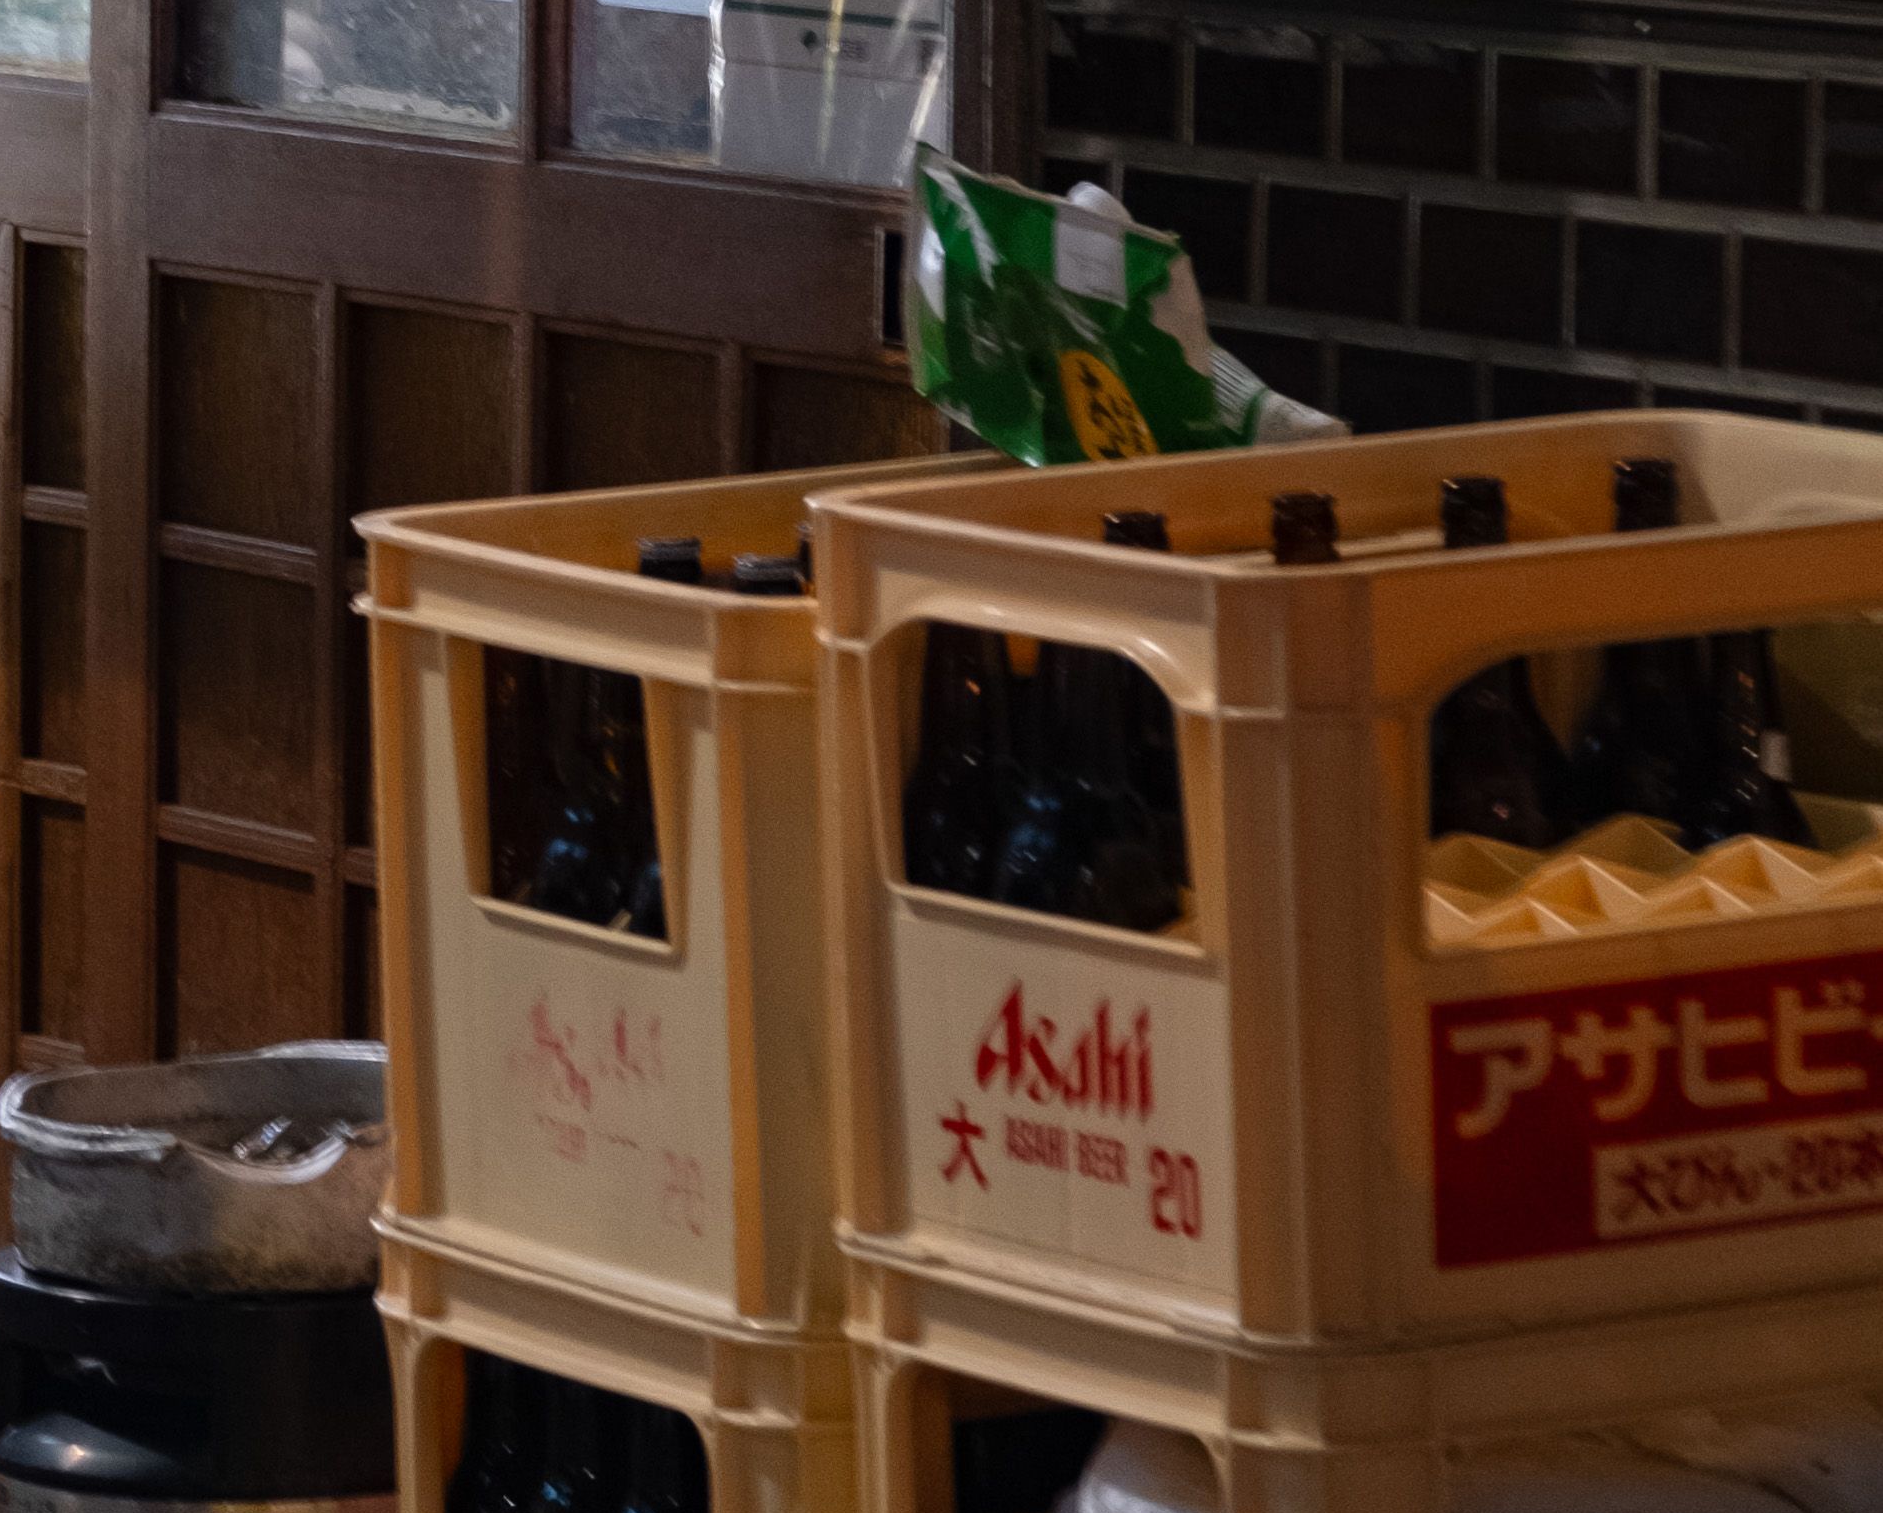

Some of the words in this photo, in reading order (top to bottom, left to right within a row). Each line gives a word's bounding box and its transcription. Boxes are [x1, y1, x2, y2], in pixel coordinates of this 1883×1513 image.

[976, 978, 1154, 1124] Asahi
[1447, 978, 1883, 1140] アサヒビ
[939, 1100, 990, 1191] 大
[1147, 1144, 1202, 1238] 20
